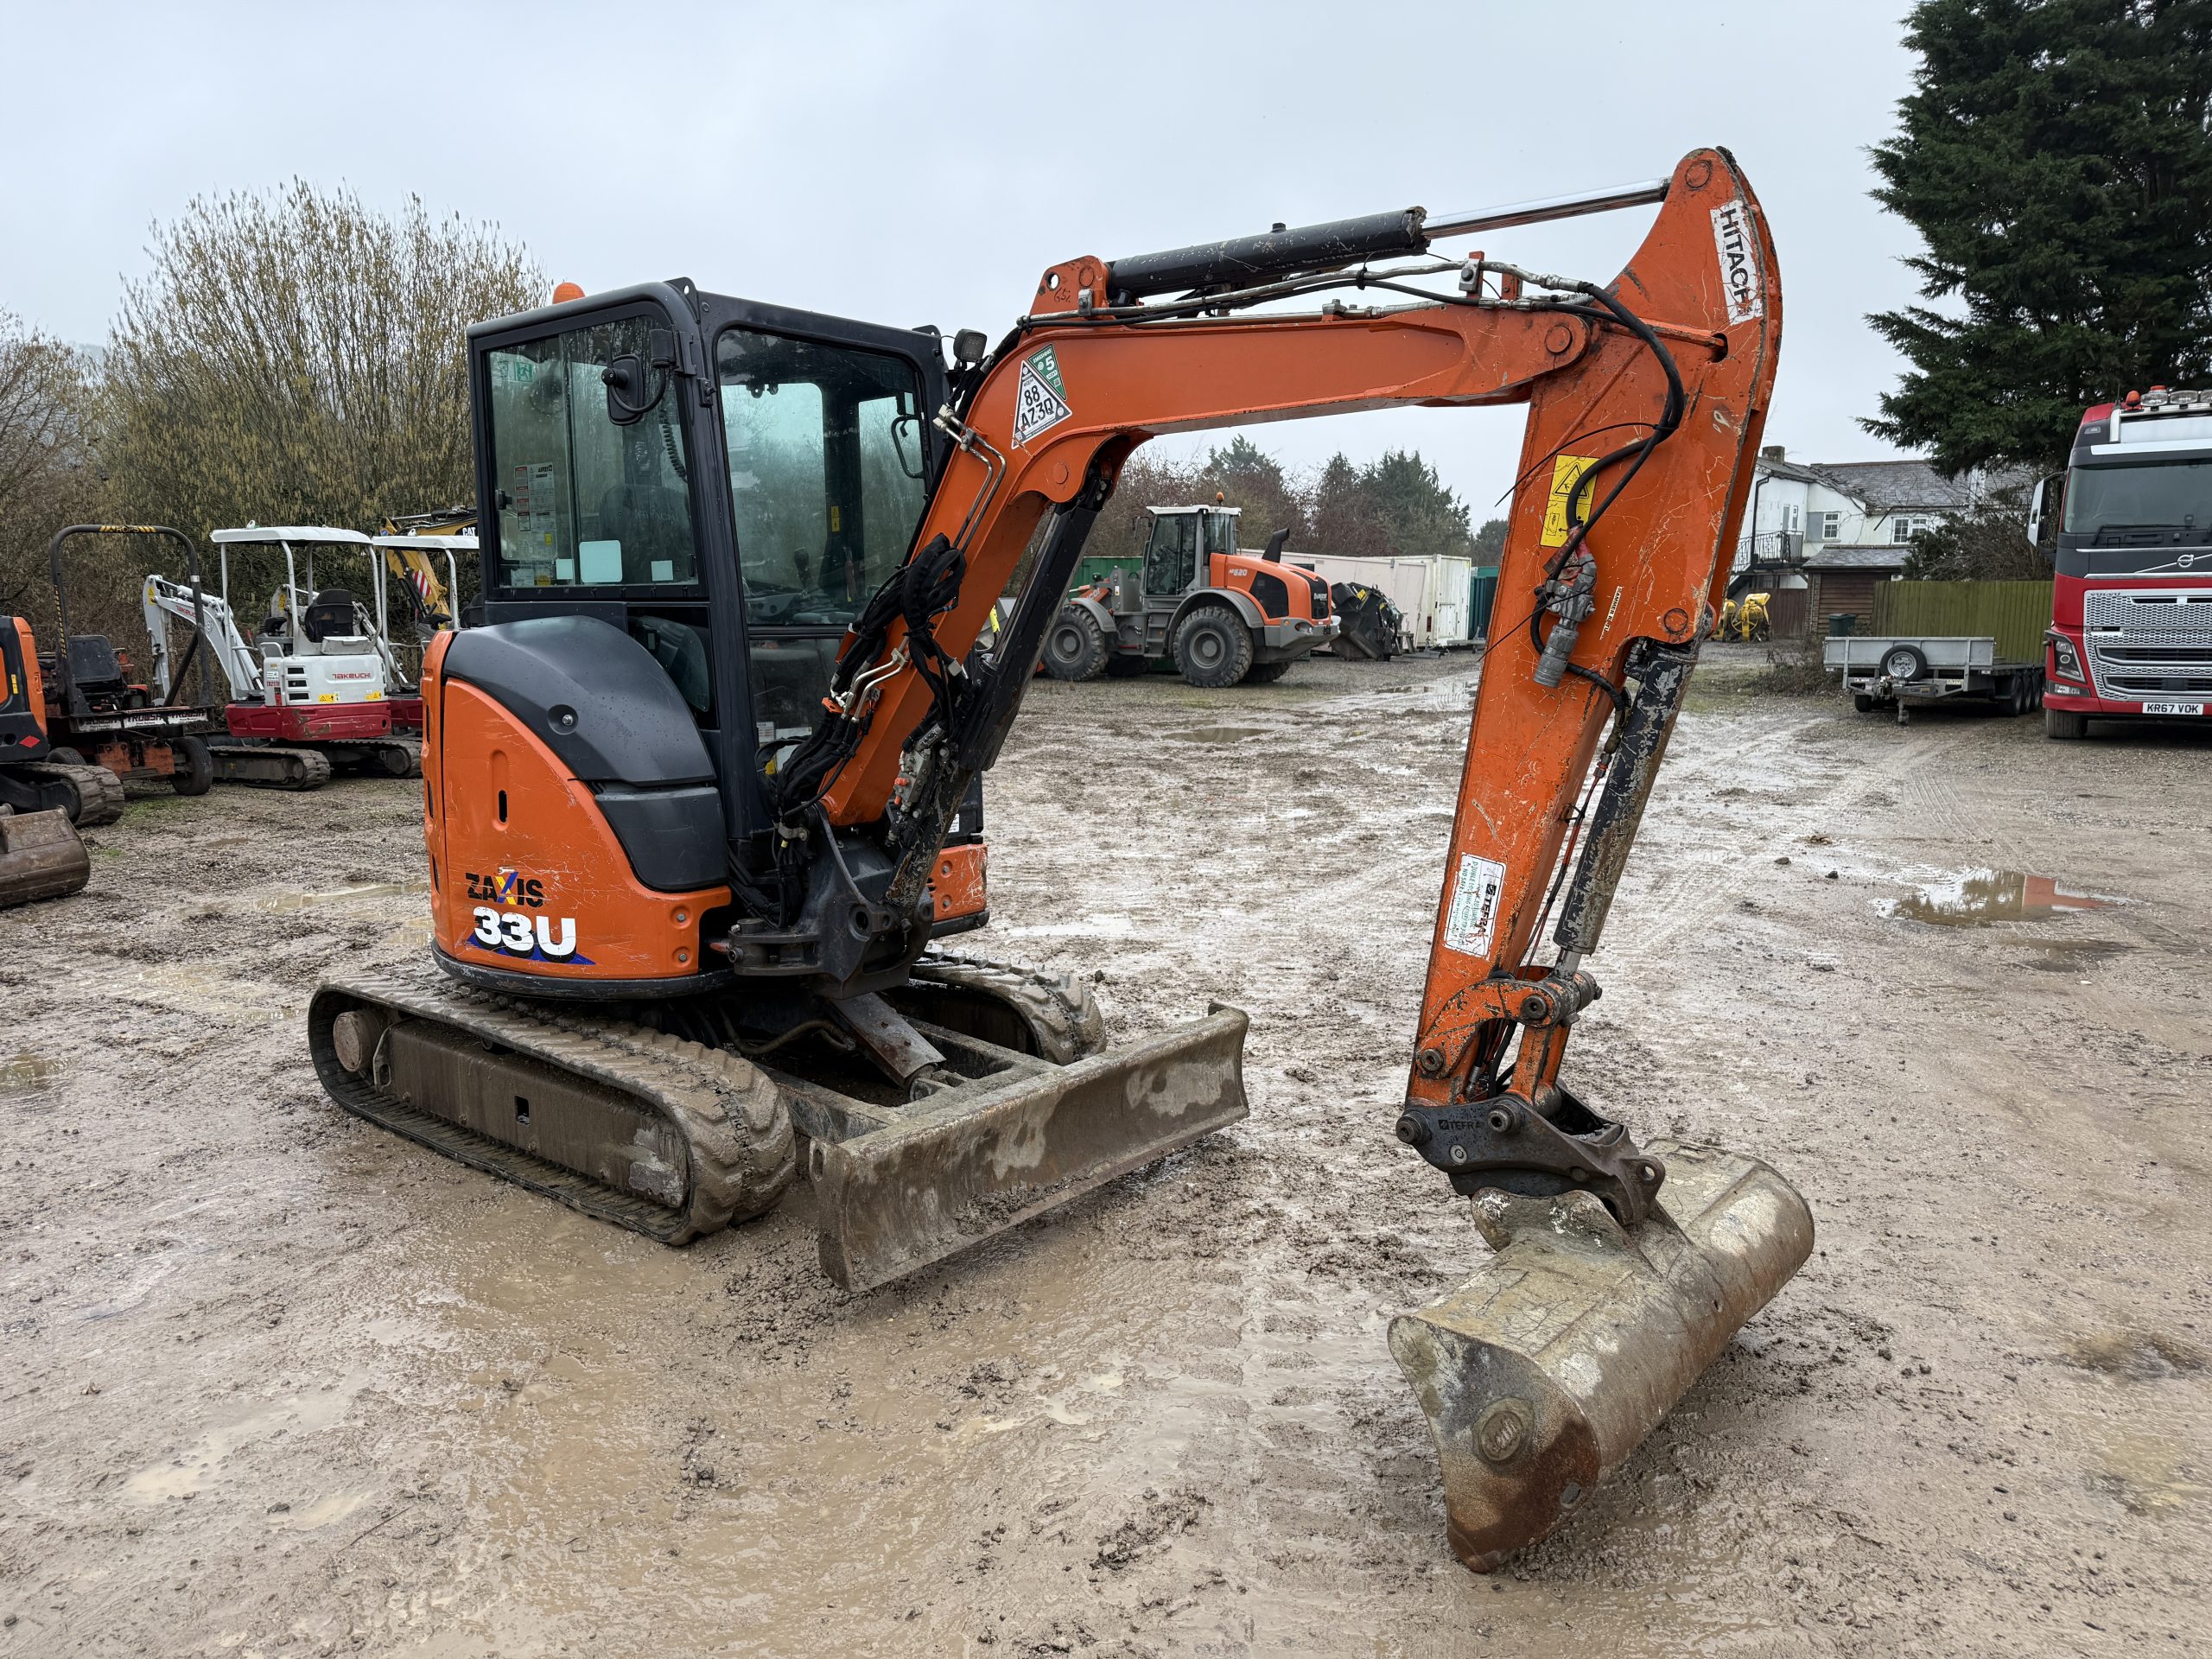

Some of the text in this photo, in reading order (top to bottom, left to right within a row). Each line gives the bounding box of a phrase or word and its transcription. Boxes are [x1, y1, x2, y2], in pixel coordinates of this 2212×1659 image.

[1046, 356, 1055, 371] 5
[1024, 385, 1040, 407] 88
[1021, 397, 1055, 429] AZ3Q
[462, 526, 476, 537] CAT
[2146, 703, 2199, 714] KR67 VOK
[465, 871, 544, 907] ZAXIS
[474, 906, 576, 961] 33U
